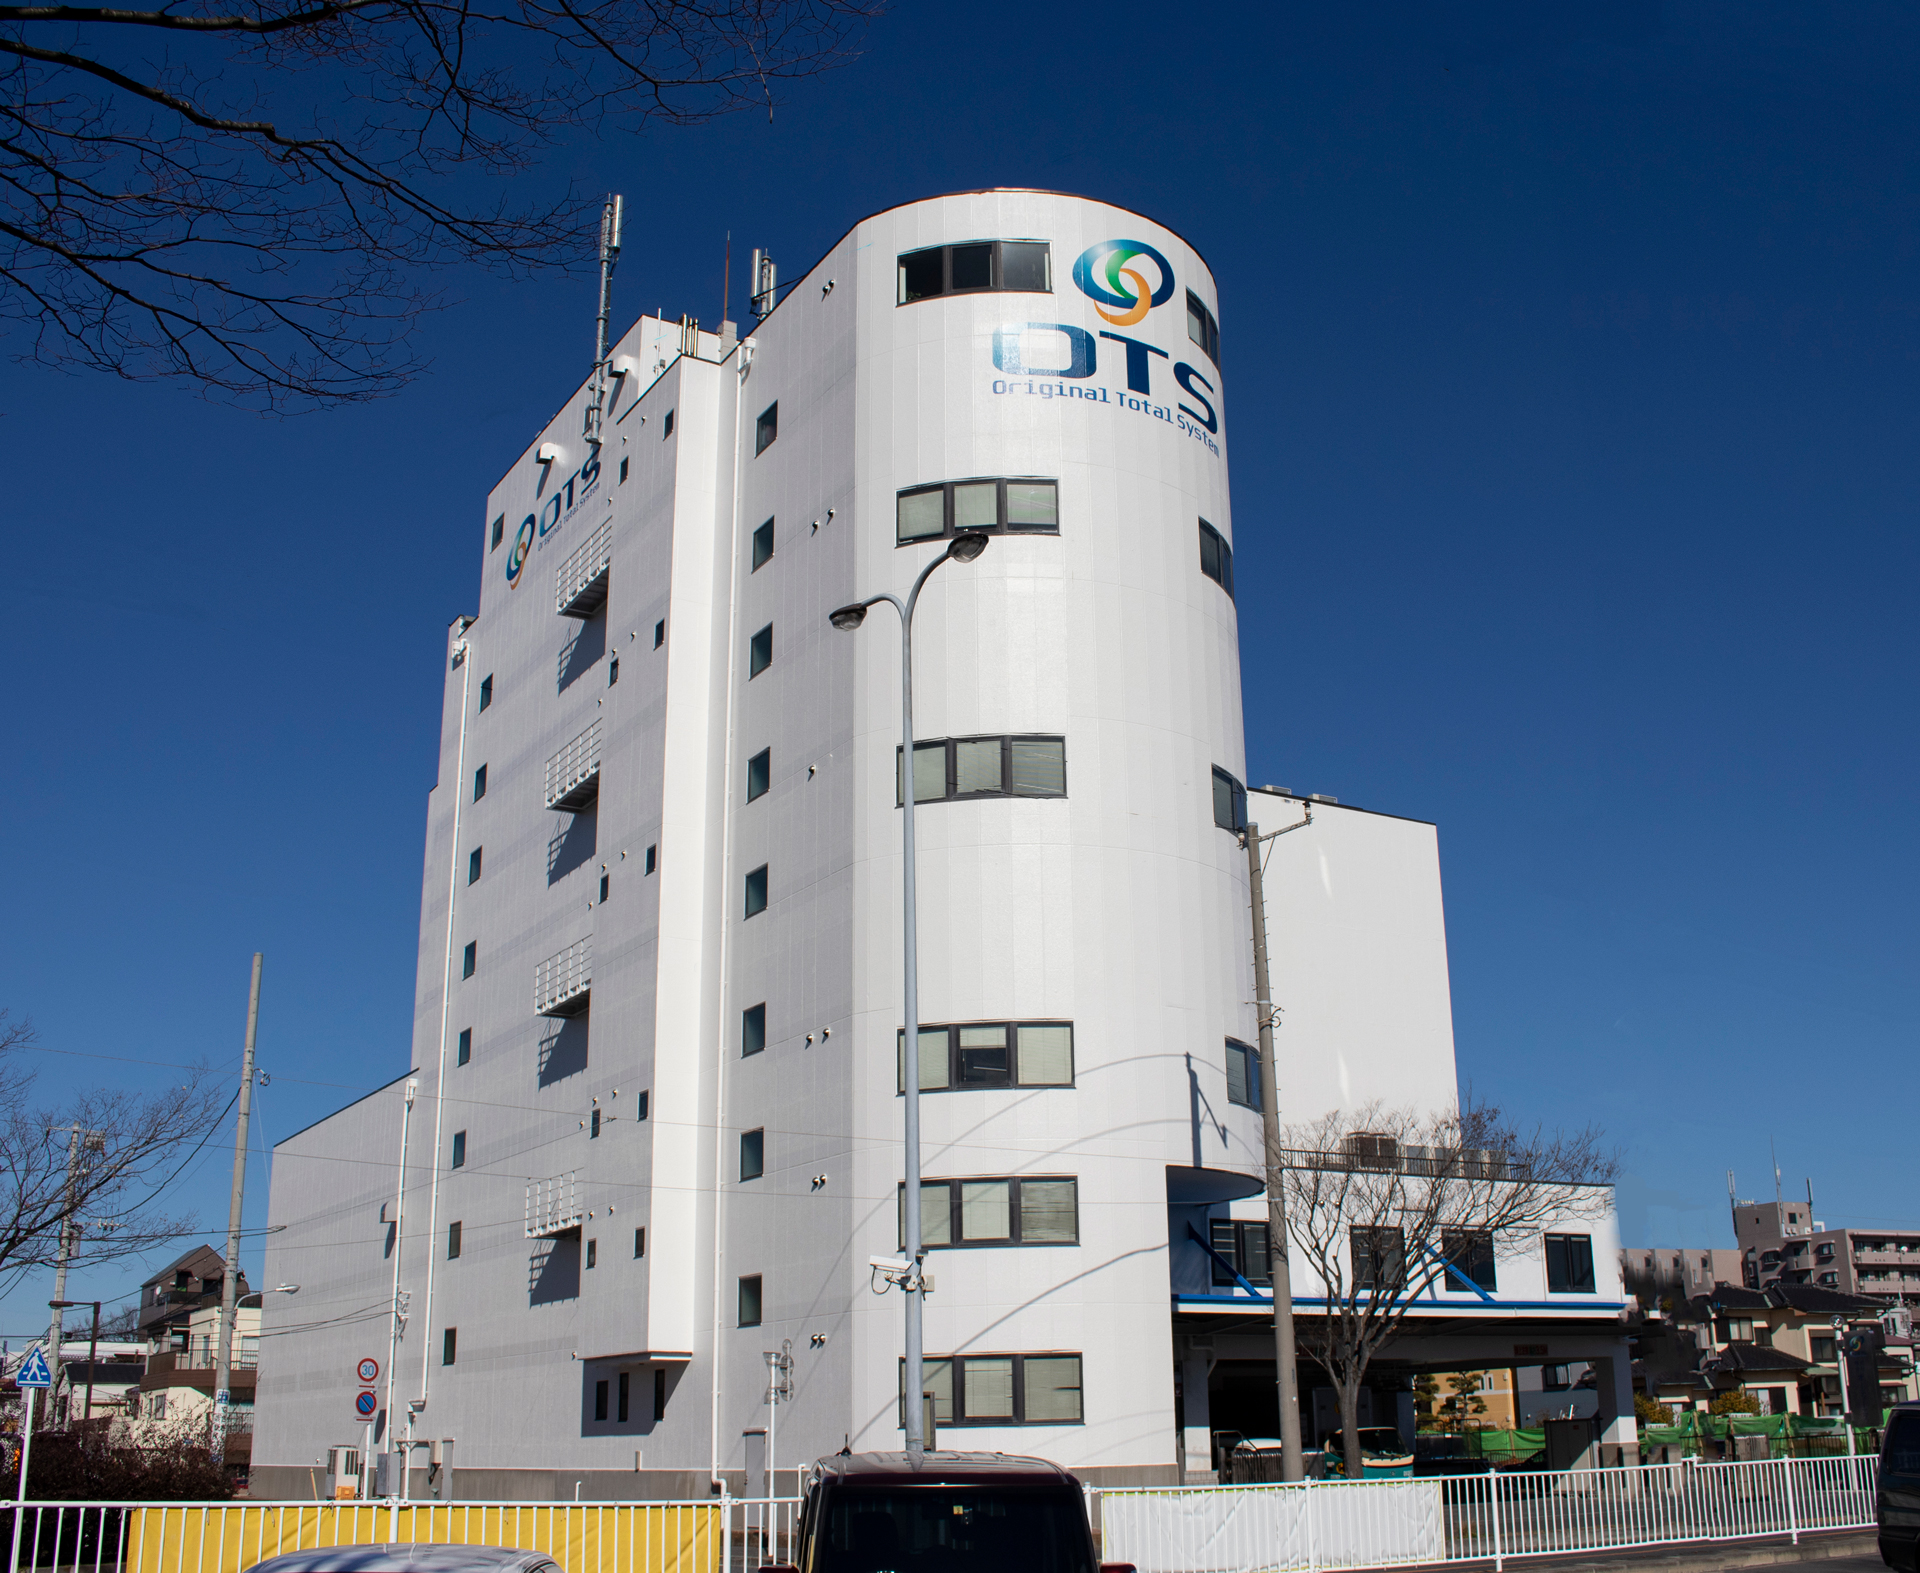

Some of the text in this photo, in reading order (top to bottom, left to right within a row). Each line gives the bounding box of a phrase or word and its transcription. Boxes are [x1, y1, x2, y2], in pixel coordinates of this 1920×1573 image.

[992, 322, 1218, 435] OTS
[992, 380, 1219, 458] Original Total System
[538, 482, 600, 551] Original Total System
[539, 446, 601, 537] OTS
[361, 1364, 375, 1376] 30
